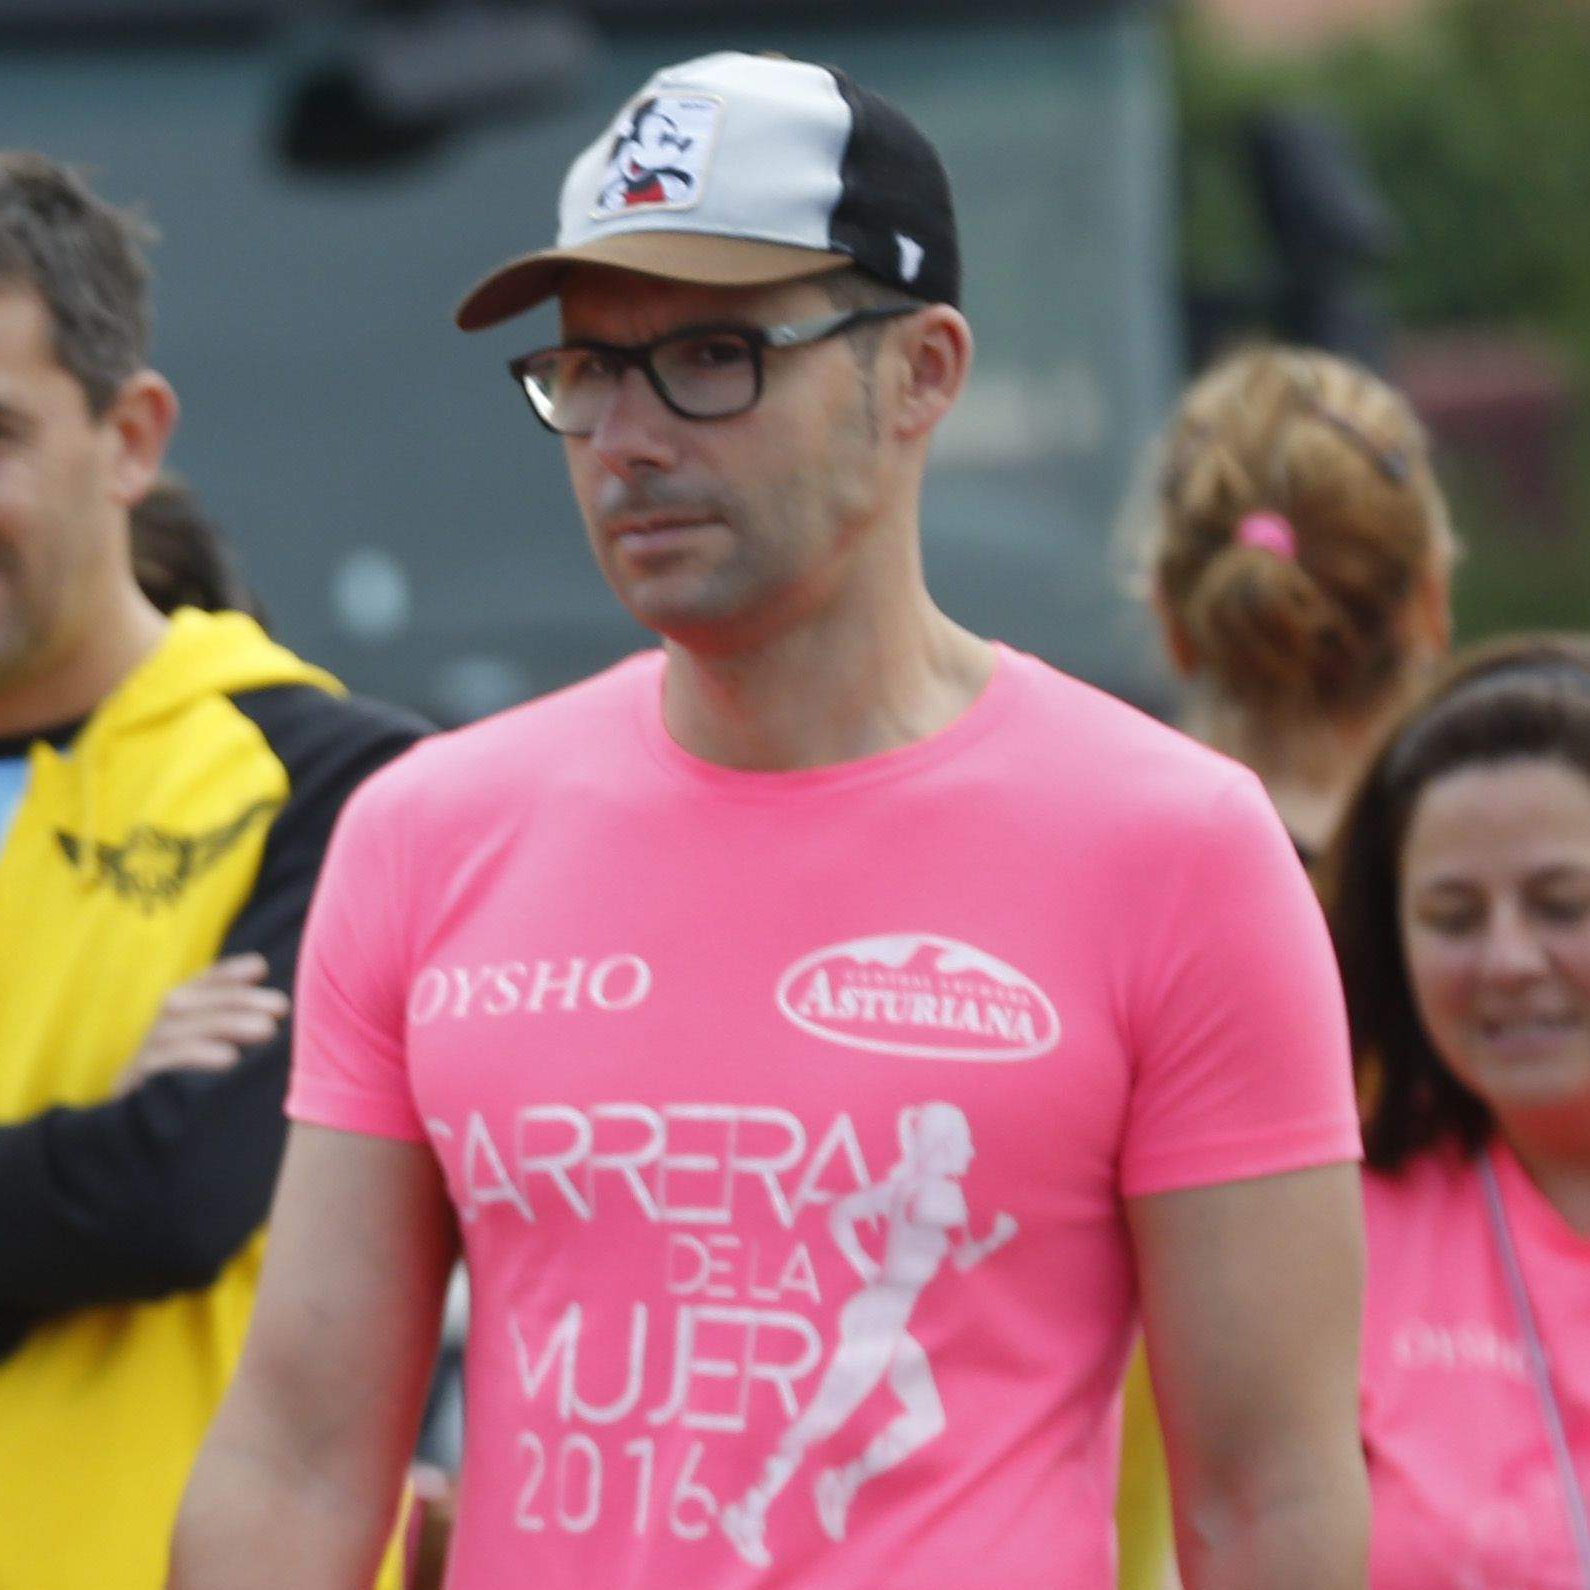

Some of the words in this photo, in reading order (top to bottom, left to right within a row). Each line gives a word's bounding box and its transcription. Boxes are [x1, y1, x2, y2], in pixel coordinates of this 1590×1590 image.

[409, 954, 652, 1026] OYSHO
[800, 968, 1040, 1047] ASTURIANA
[669, 1233, 741, 1299] DE
[749, 1240, 824, 1305] LA
[507, 1301, 823, 1433] MUJER
[515, 1431, 718, 1539] 2016
